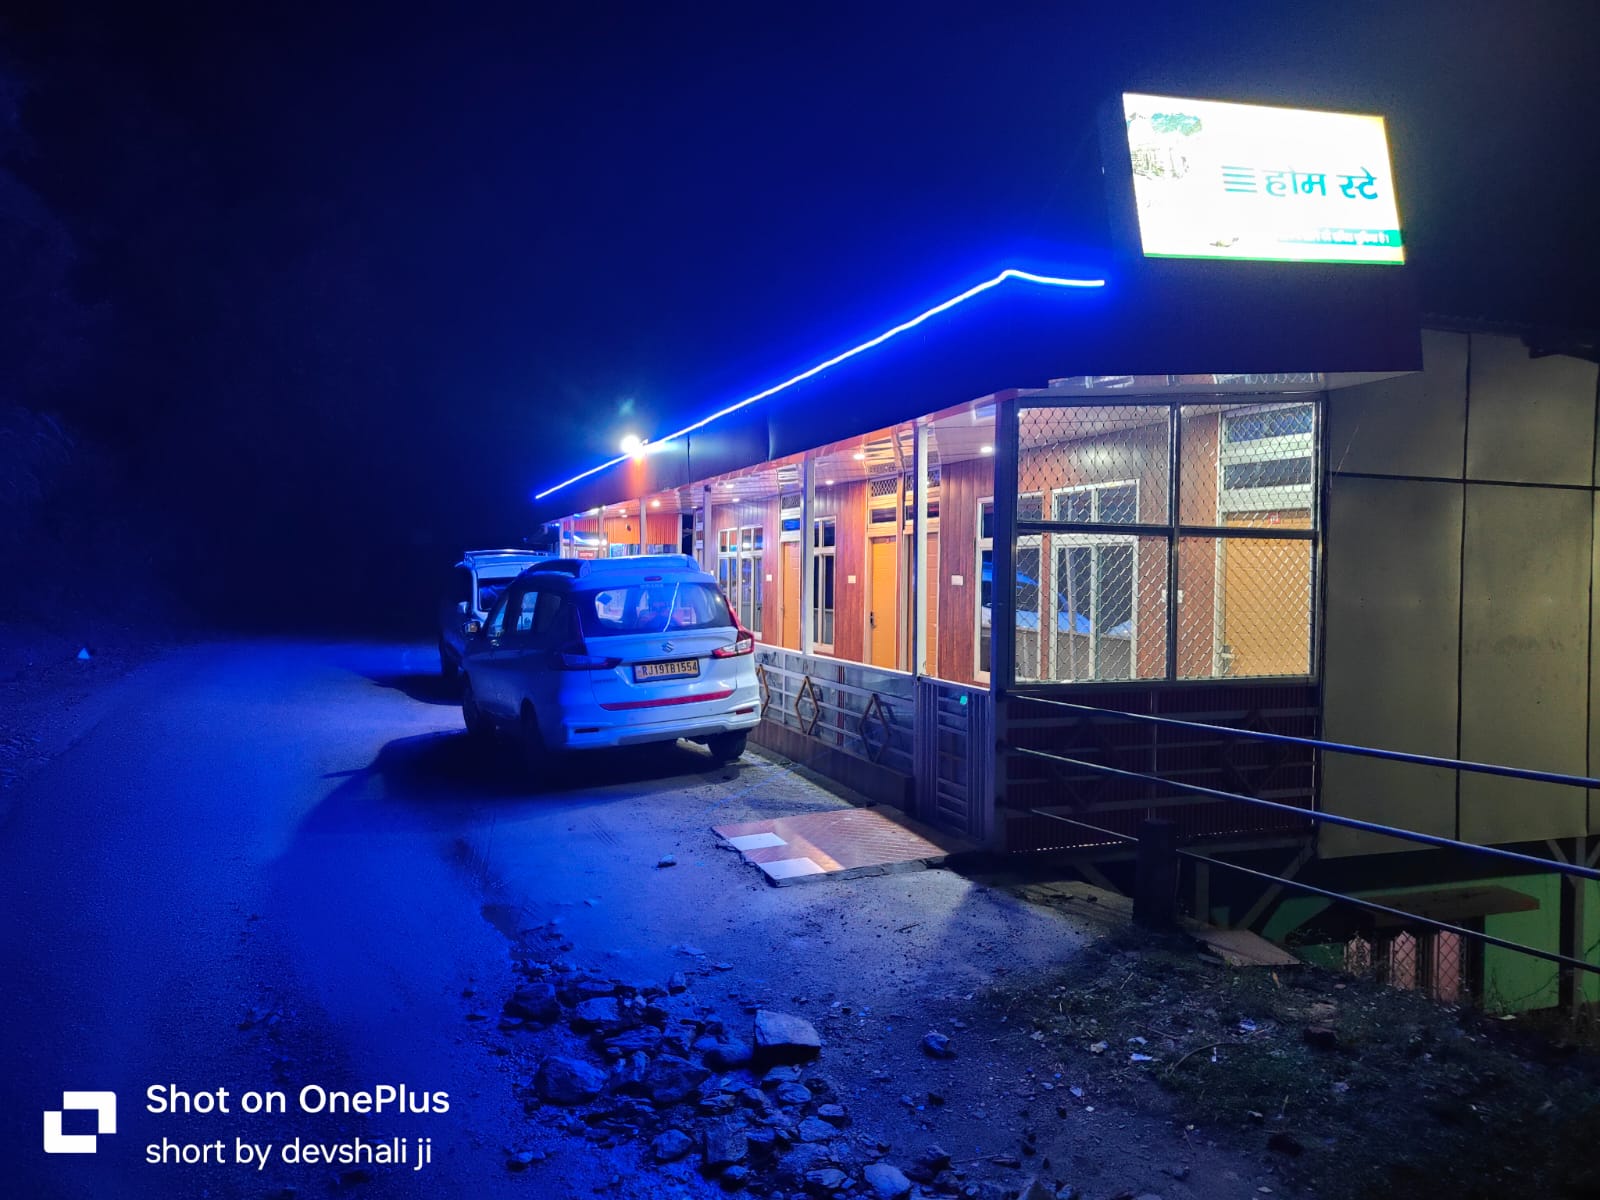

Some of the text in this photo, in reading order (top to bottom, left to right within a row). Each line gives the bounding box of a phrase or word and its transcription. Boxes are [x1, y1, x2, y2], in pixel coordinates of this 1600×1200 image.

[1262, 166, 1380, 201] होम स्टे
[642, 661, 698, 677] RJ19TB1554
